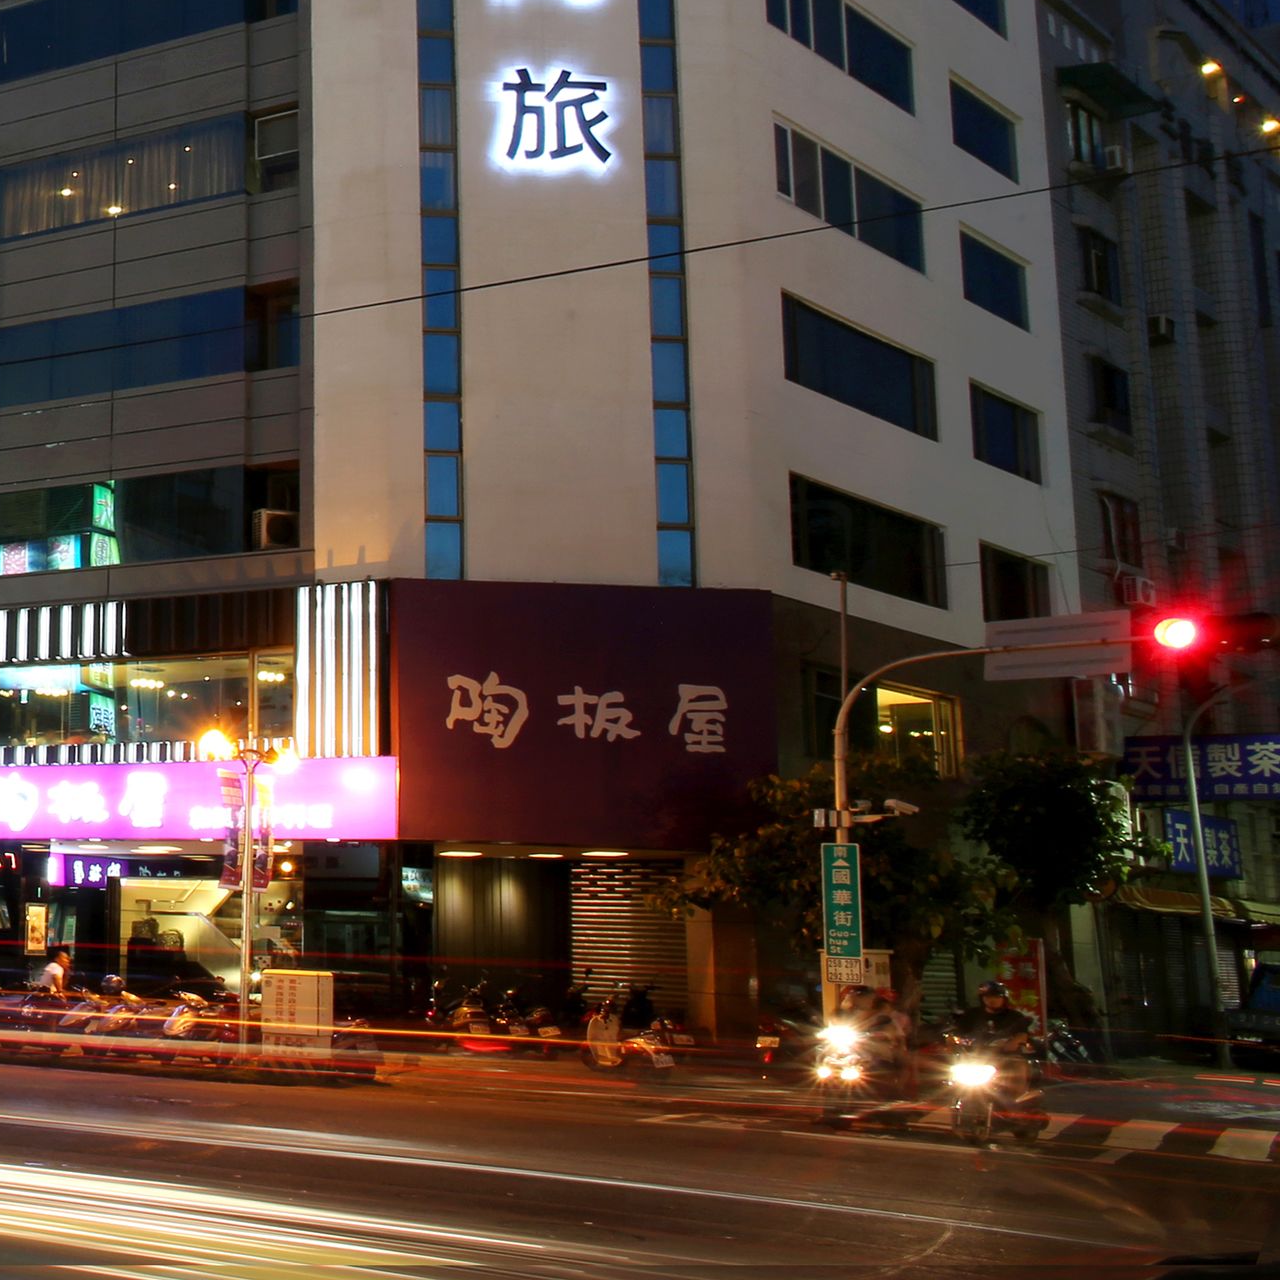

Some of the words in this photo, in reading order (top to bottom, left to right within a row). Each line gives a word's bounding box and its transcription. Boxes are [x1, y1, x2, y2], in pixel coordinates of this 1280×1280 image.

[445, 670, 729, 754] 陶板屋
[1126, 741, 1280, 780] 天信製茶
[1175, 822, 1233, 869] 天製茶
[831, 868, 854, 927] 國華街
[828, 928, 857, 938] Guo-
